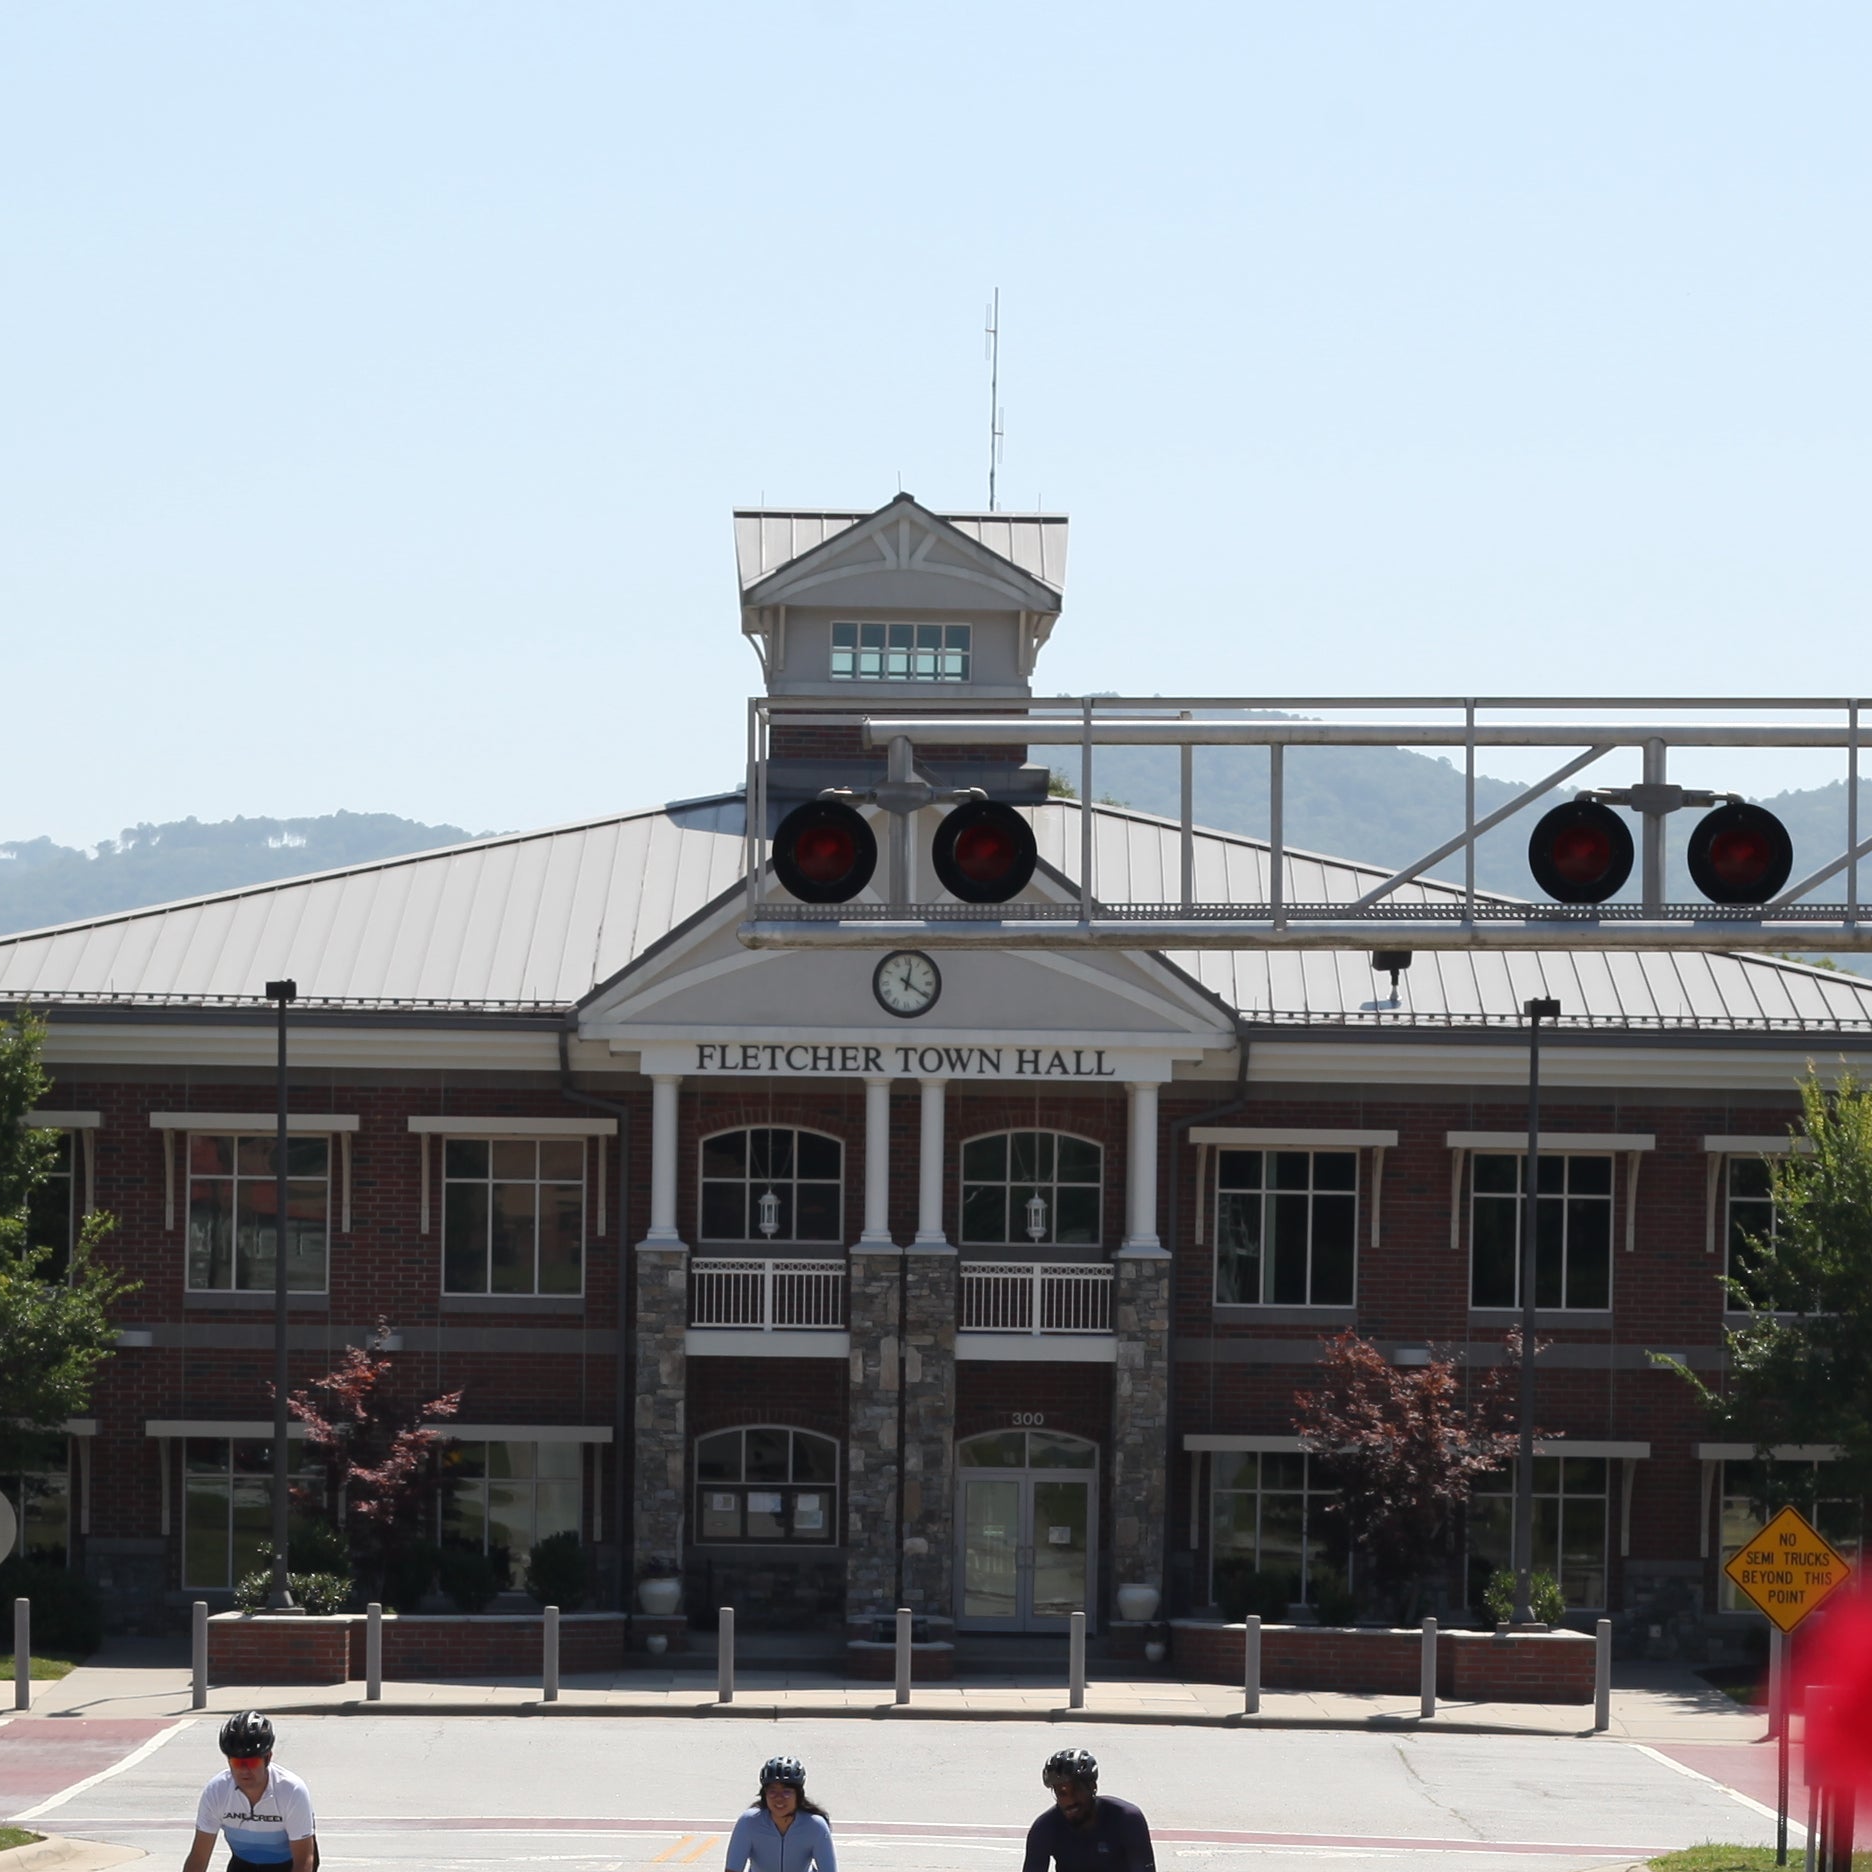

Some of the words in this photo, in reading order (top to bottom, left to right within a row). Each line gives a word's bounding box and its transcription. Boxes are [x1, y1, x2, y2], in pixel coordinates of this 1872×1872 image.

[696, 1044, 884, 1072] FLETCHER
[895, 1047, 1003, 1073] TOWN
[1015, 1049, 1116, 1075] HALL
[1012, 1412, 1044, 1425] 300
[1779, 1533, 1797, 1547] NO
[1746, 1551, 1774, 1565] SEMI
[1784, 1552, 1830, 1566] TRUCKS
[1742, 1570, 1793, 1584] BEYOND
[1805, 1571, 1832, 1585] THIS
[1768, 1590, 1806, 1604] POINT
